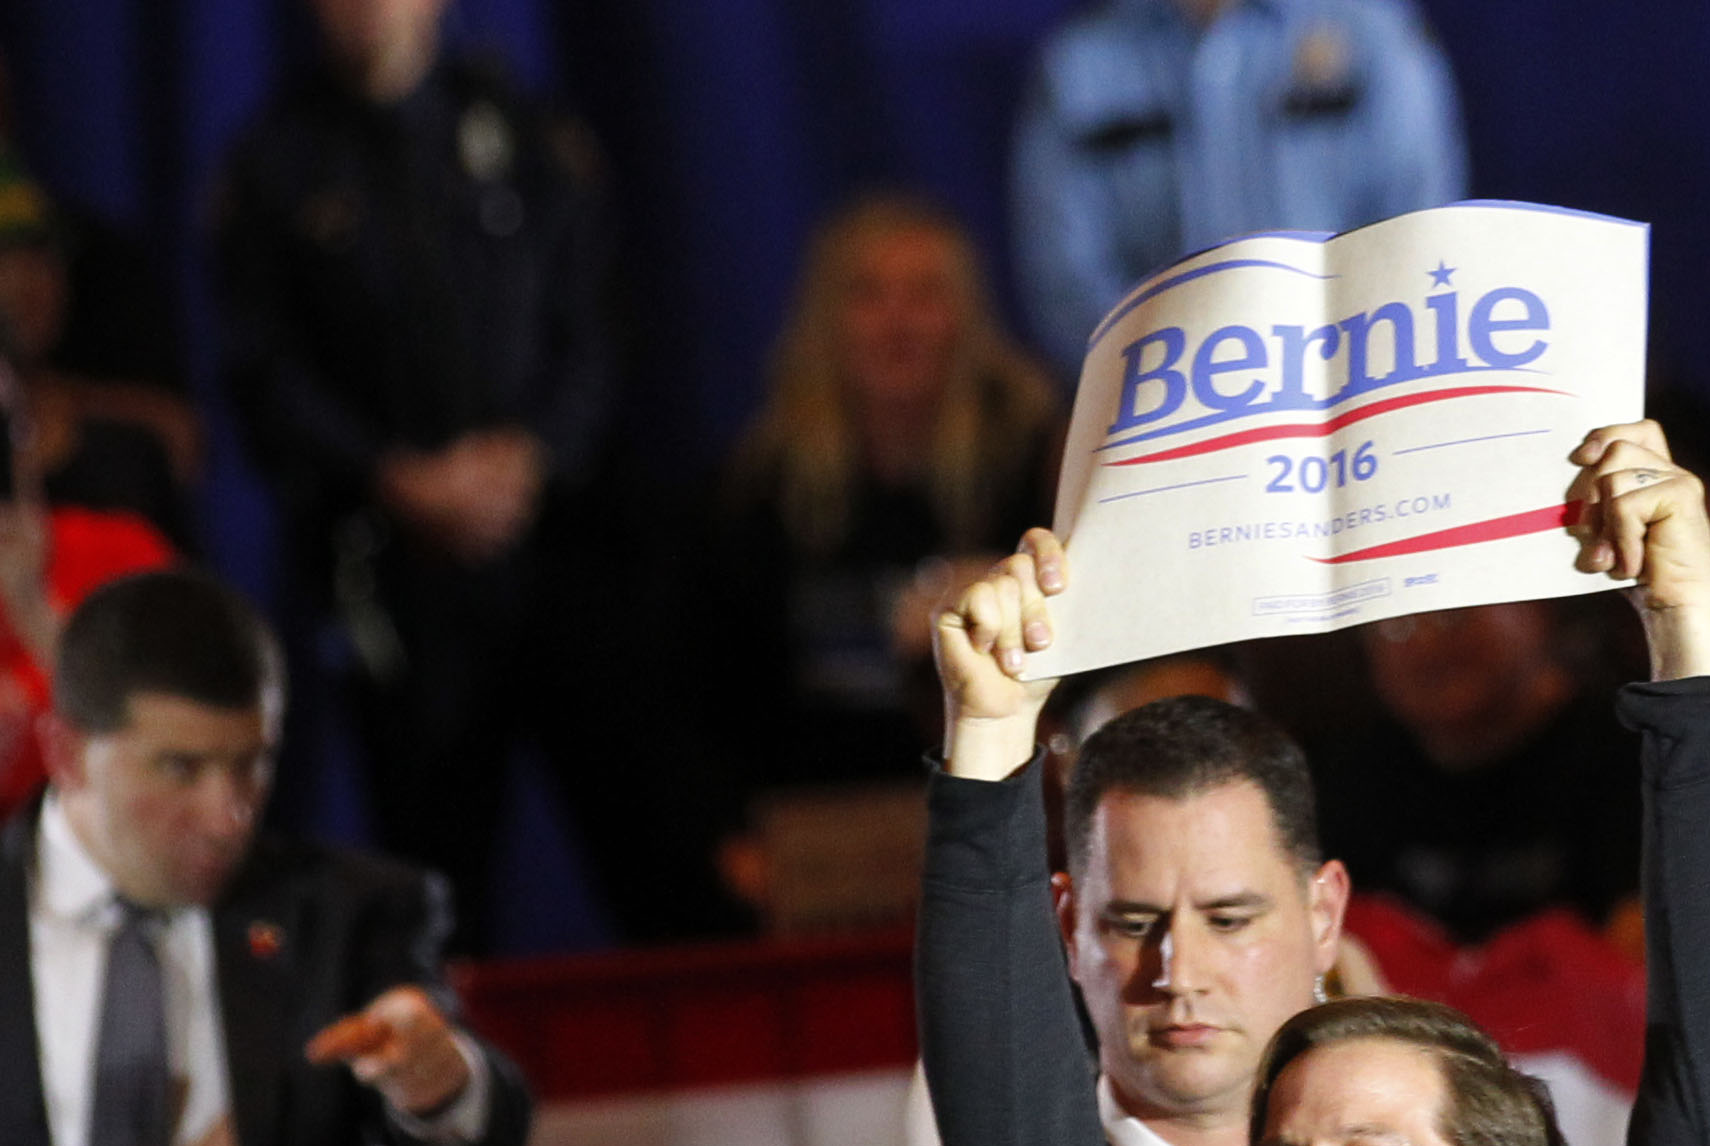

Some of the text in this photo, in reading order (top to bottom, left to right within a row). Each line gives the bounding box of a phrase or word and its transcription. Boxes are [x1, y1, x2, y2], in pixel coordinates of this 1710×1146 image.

[1107, 262, 1551, 435] Bernie
[1265, 440, 1379, 494] 2016
[1187, 493, 1452, 550] BERNIESANDERS.COM
